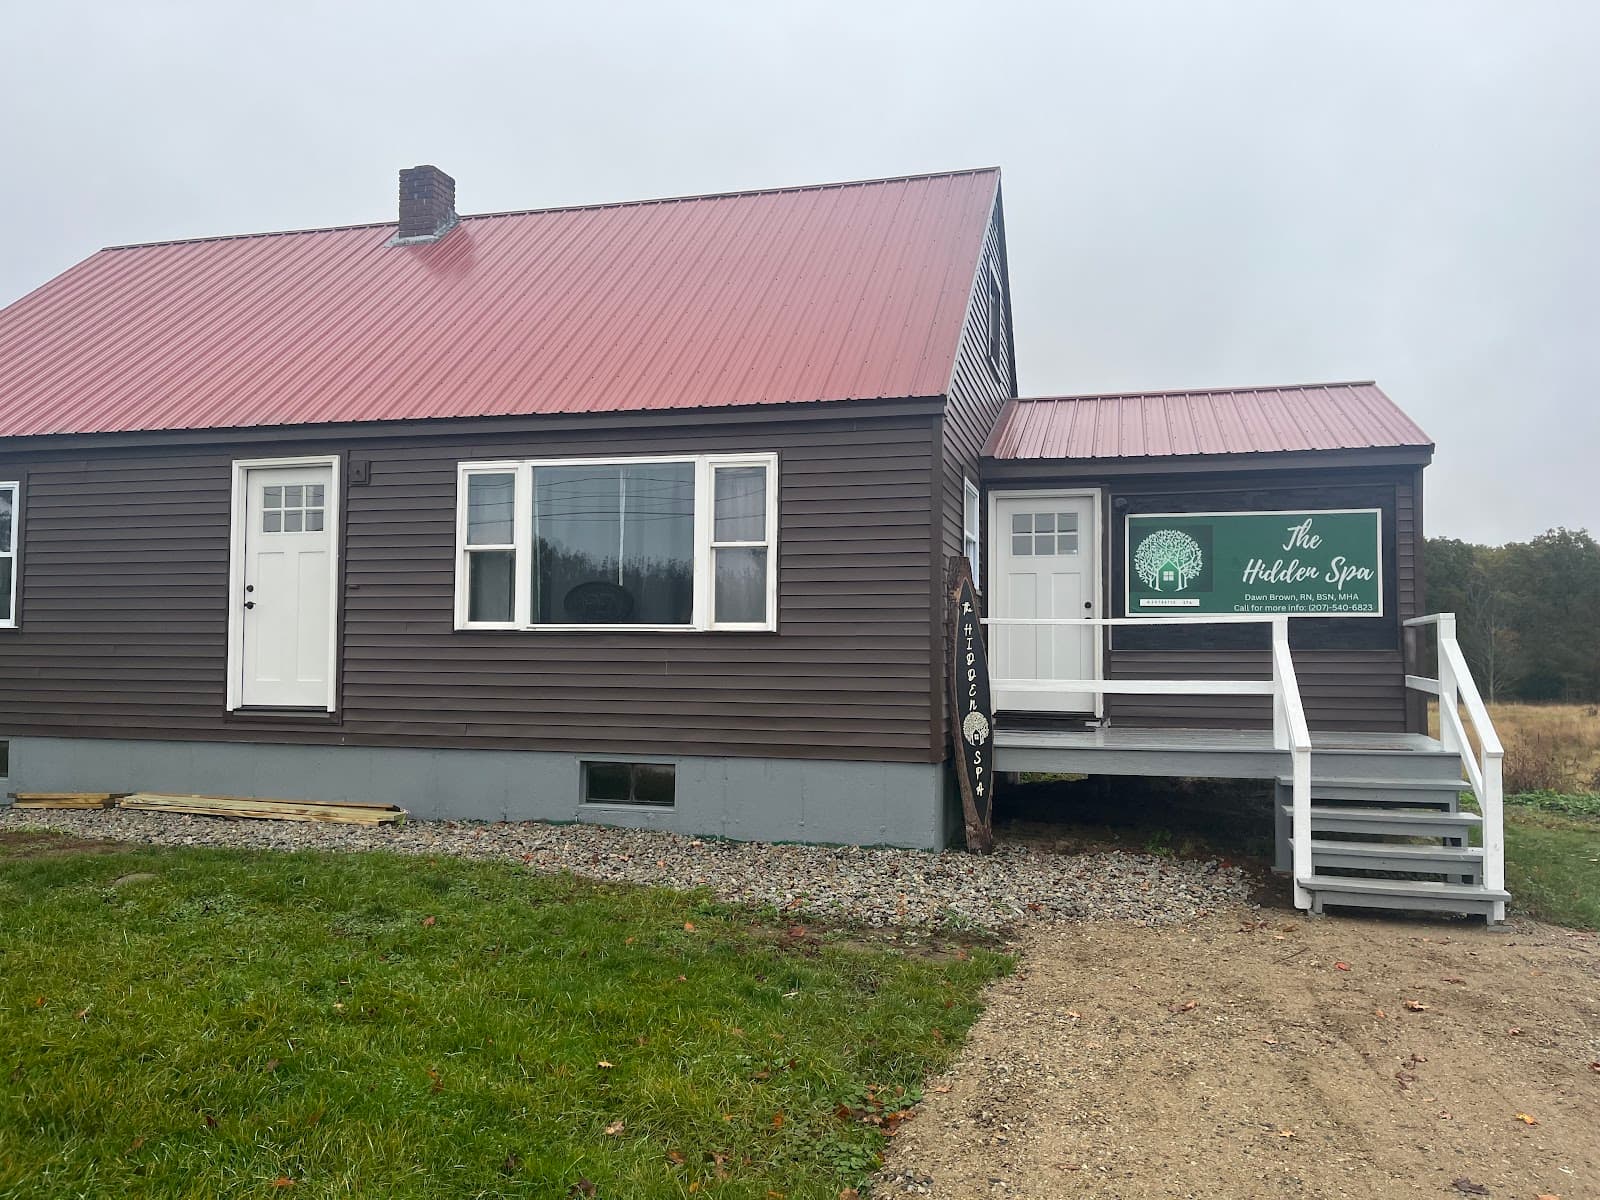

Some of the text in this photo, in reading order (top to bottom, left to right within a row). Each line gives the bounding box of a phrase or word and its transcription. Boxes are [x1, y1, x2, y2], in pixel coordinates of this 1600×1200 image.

[1282, 518, 1322, 551] The
[1242, 556, 1375, 590] Hidden Spa
[1233, 604, 1249, 612] Call
[1251, 604, 1263, 612] for
[1288, 604, 1307, 612] info:
[1308, 603, 1373, 612] (207)-540-6823
[1244, 593, 1359, 602] Dawn Brown, RN, BSN, MHA
[973, 750, 985, 797] SPA
